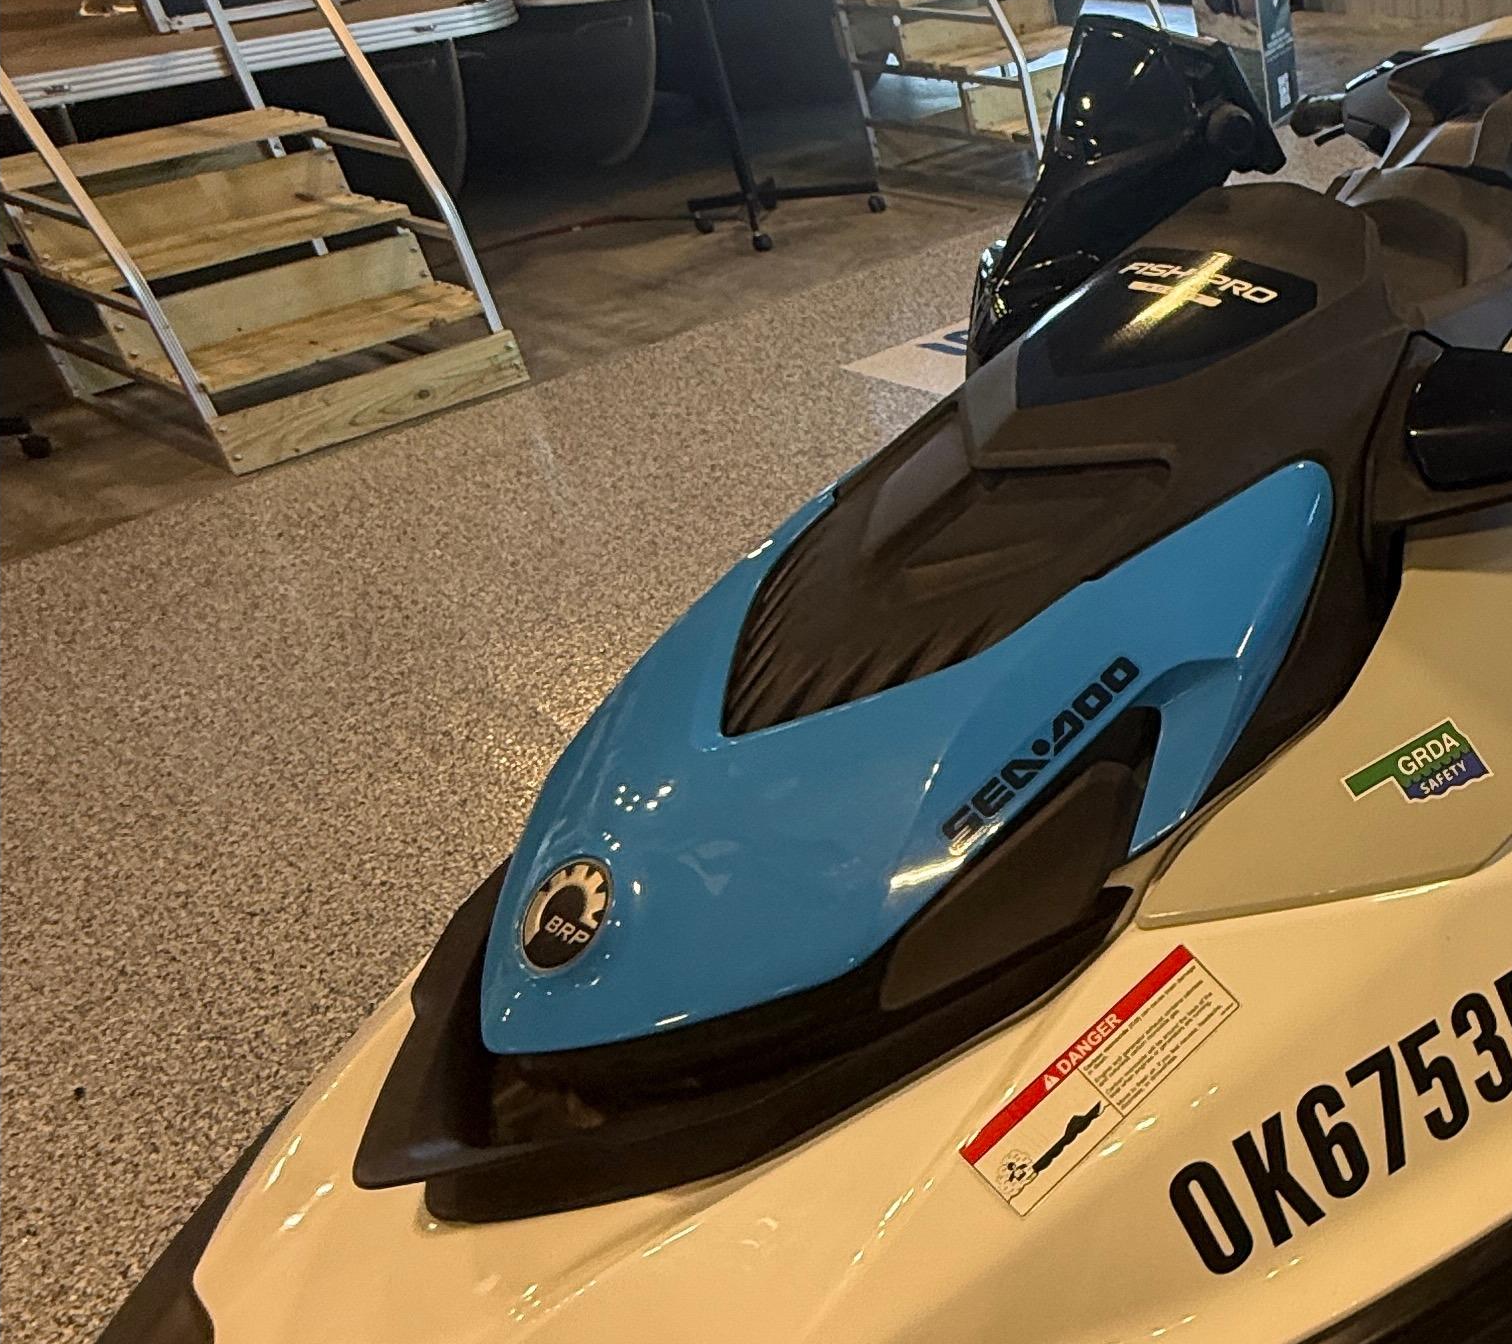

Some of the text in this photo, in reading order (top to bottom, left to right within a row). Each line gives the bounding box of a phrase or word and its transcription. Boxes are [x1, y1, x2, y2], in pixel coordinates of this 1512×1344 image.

[1397, 732, 1461, 775] GRDA
[1419, 759, 1467, 795] SAFETY
[544, 915, 591, 944] BRP
[1055, 1012, 1123, 1076] DANGER
